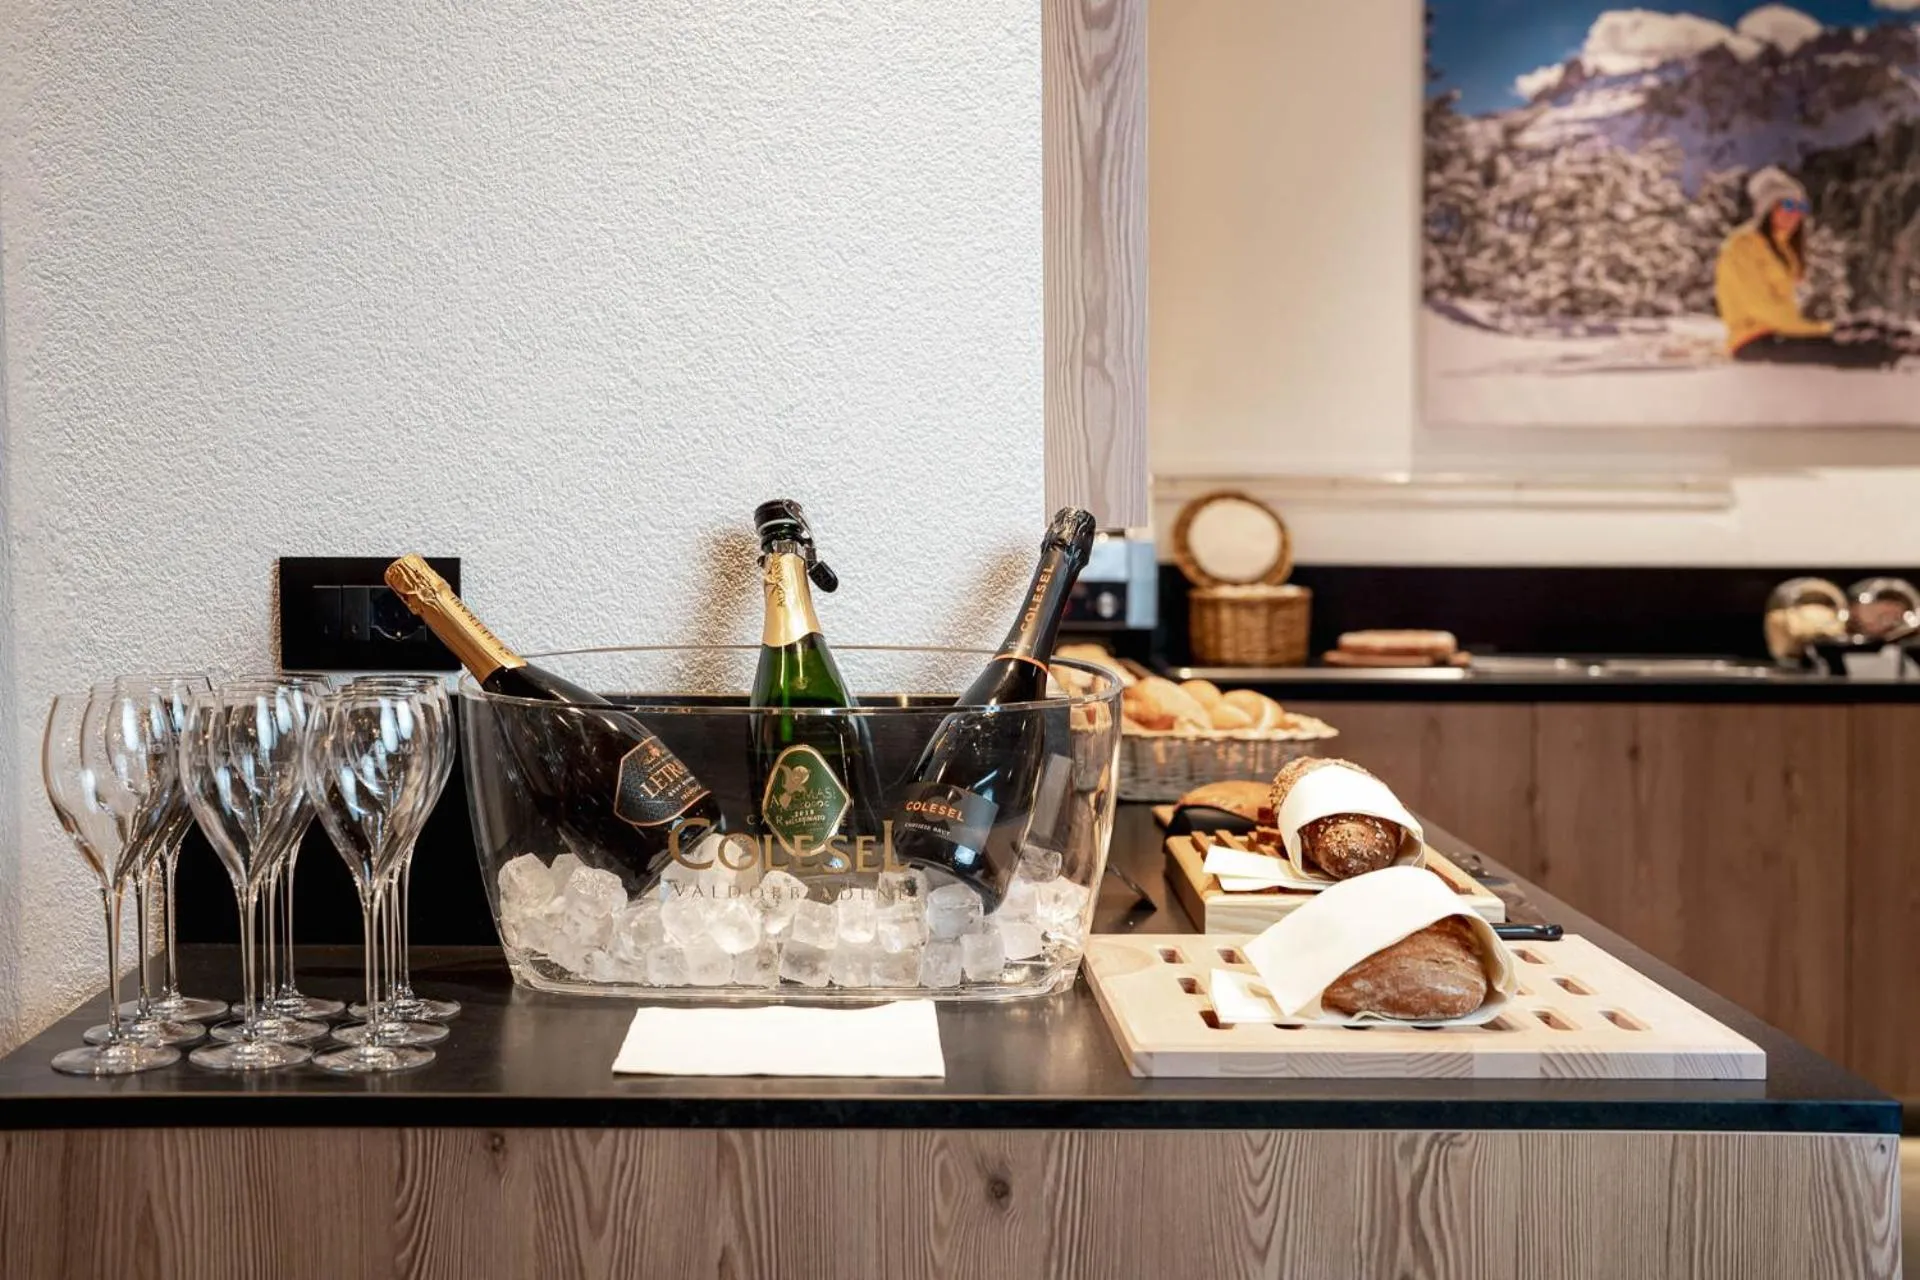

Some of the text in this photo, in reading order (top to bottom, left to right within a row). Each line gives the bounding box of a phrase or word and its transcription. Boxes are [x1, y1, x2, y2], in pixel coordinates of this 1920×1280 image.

[1020, 564, 1055, 632] COLESEL
[640, 761, 687, 799] LETR
[905, 801, 964, 823] COLESEL
[668, 818, 911, 873] COLESEL
[674, 883, 910, 900] VALDOBBADENE
